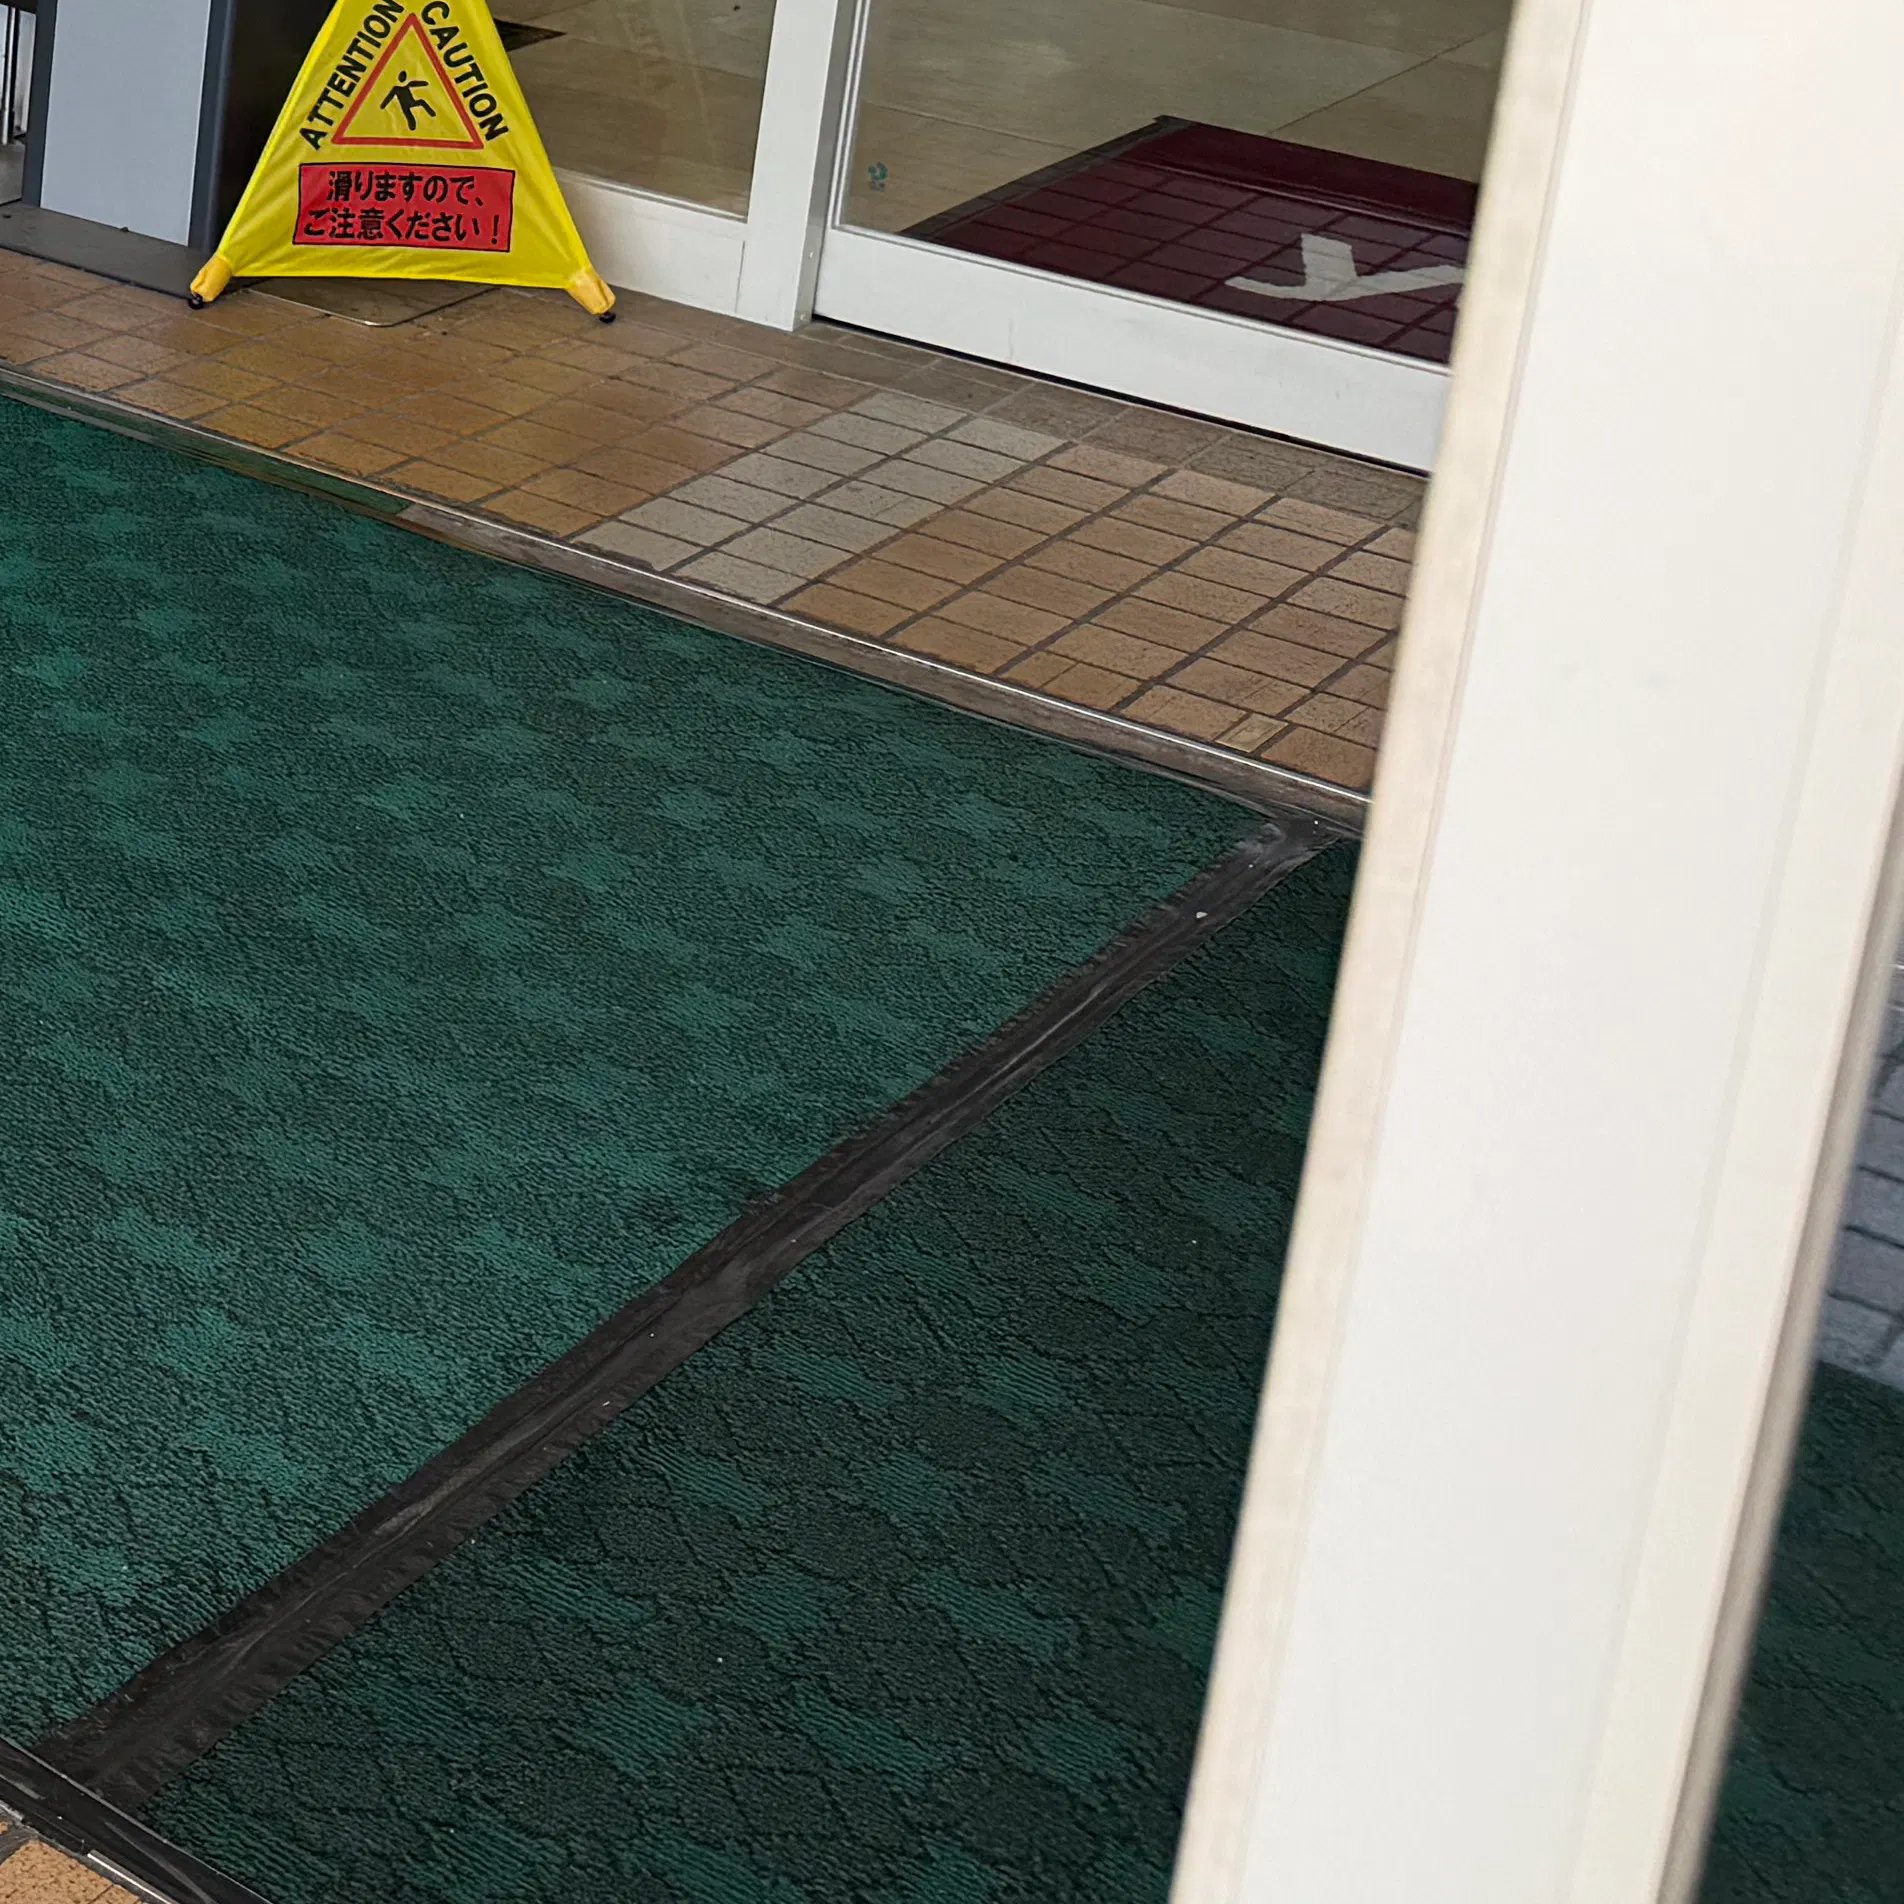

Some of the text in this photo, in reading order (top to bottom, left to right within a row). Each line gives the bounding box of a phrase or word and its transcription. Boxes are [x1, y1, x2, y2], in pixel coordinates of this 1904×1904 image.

[420, 0, 510, 143] CAUTION
[327, 169, 486, 210] 滑りますので、
[302, 206, 502, 246] ご注意ください!
